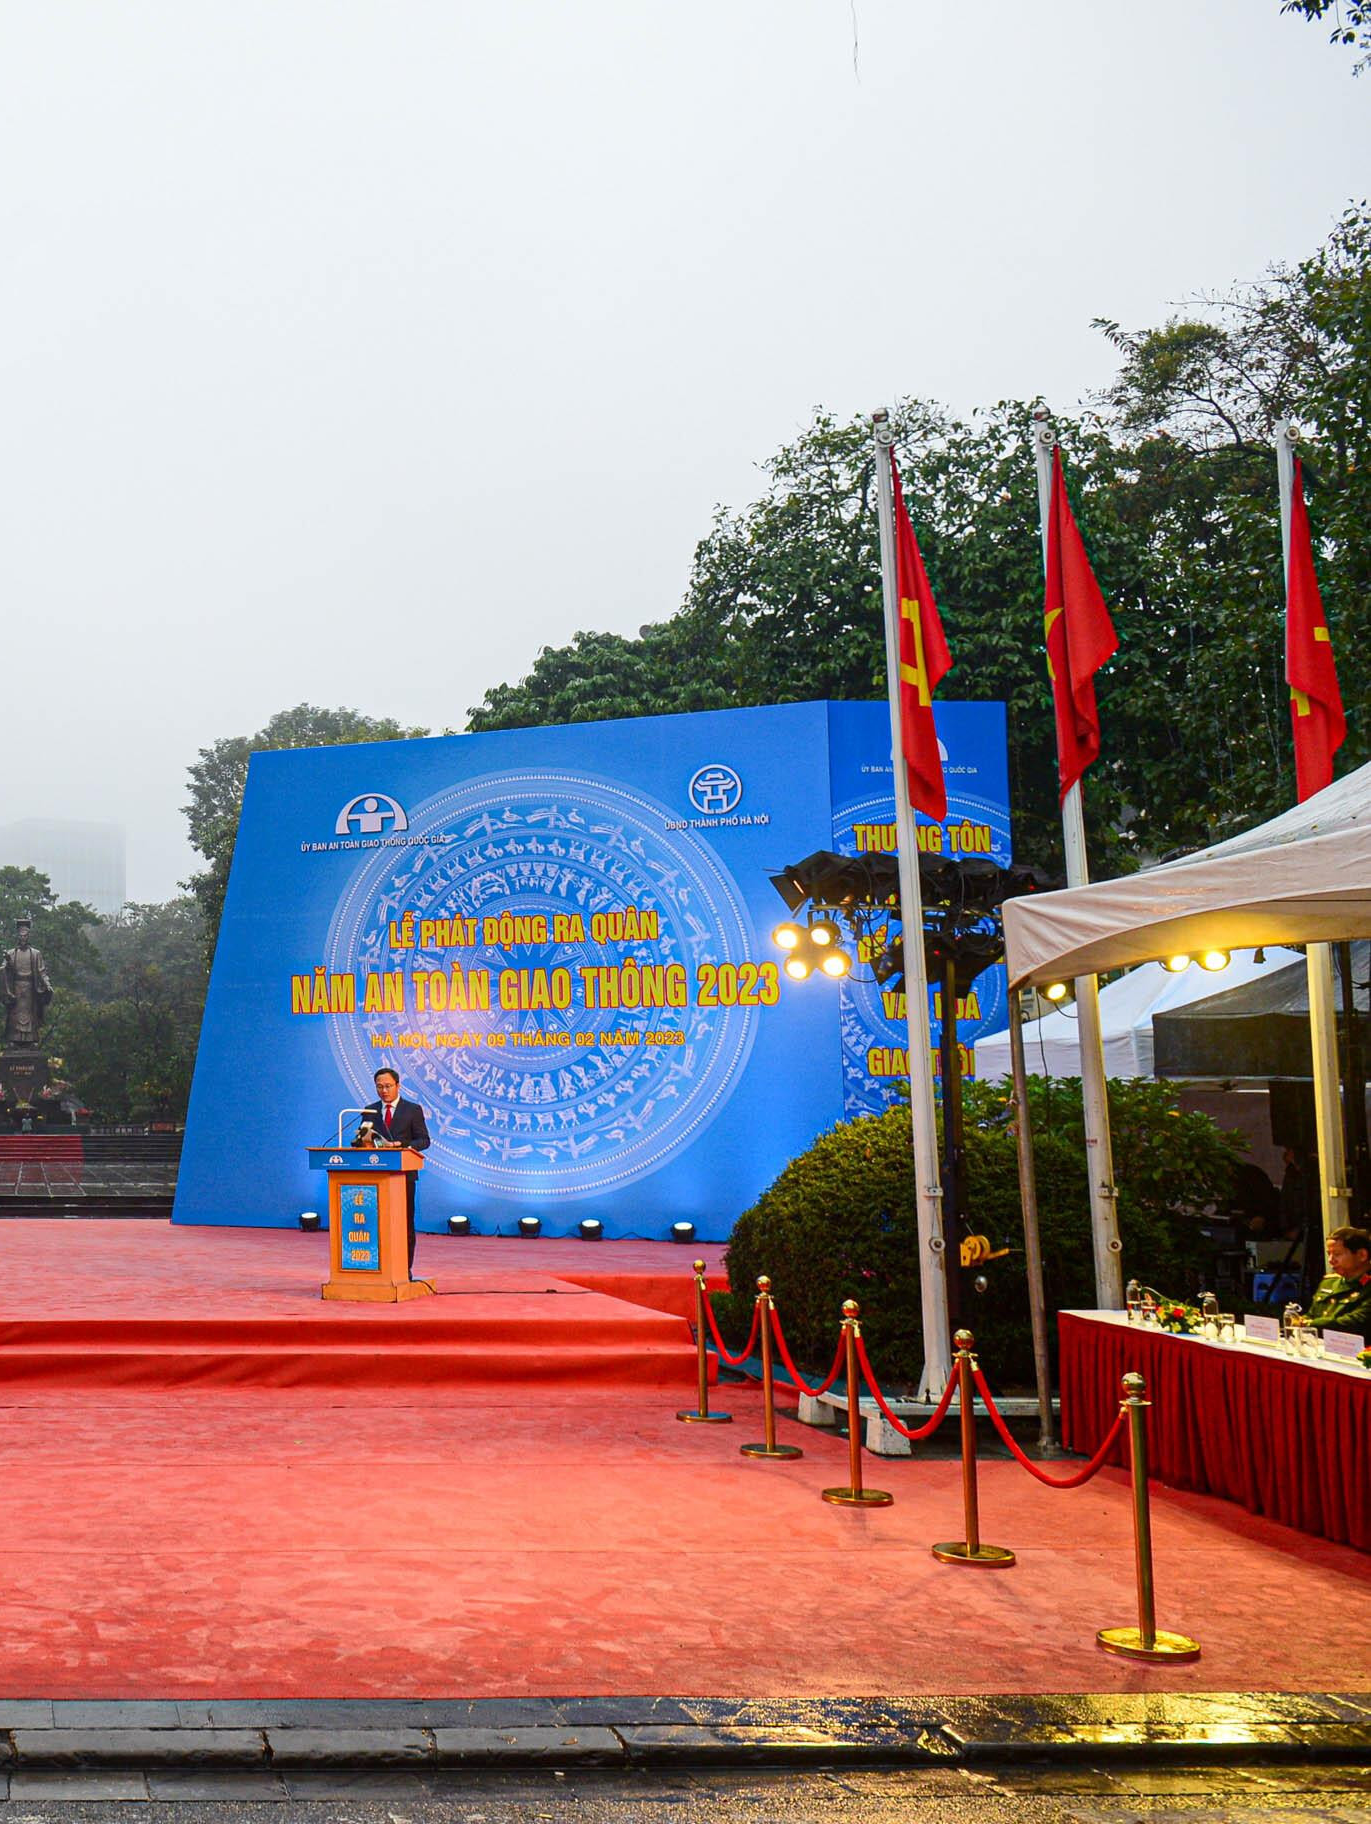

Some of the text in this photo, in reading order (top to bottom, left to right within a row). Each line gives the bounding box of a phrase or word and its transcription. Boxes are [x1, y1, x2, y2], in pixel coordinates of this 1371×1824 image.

[664, 812, 770, 831] UBND THÀNH PHỐ HÀ NỘI
[301, 833, 446, 852] ỦY BAN AN TOÀN GIAO THÔNG QUỐC GIA
[853, 819, 992, 853] THƯNG TÔN
[388, 905, 658, 951] LỄ PHÁT ĐỘNG RA QUÂN
[291, 956, 780, 1015] NĂM AN TOÀN GIAO THÔNG 2023
[372, 1029, 685, 1050] HÀ NỘI, NGÀY 09 THÁNG 02 NĂM 2023
[867, 1047, 911, 1077] GIA
[354, 1213, 366, 1224] RA
[351, 1250, 370, 1262] 2023
